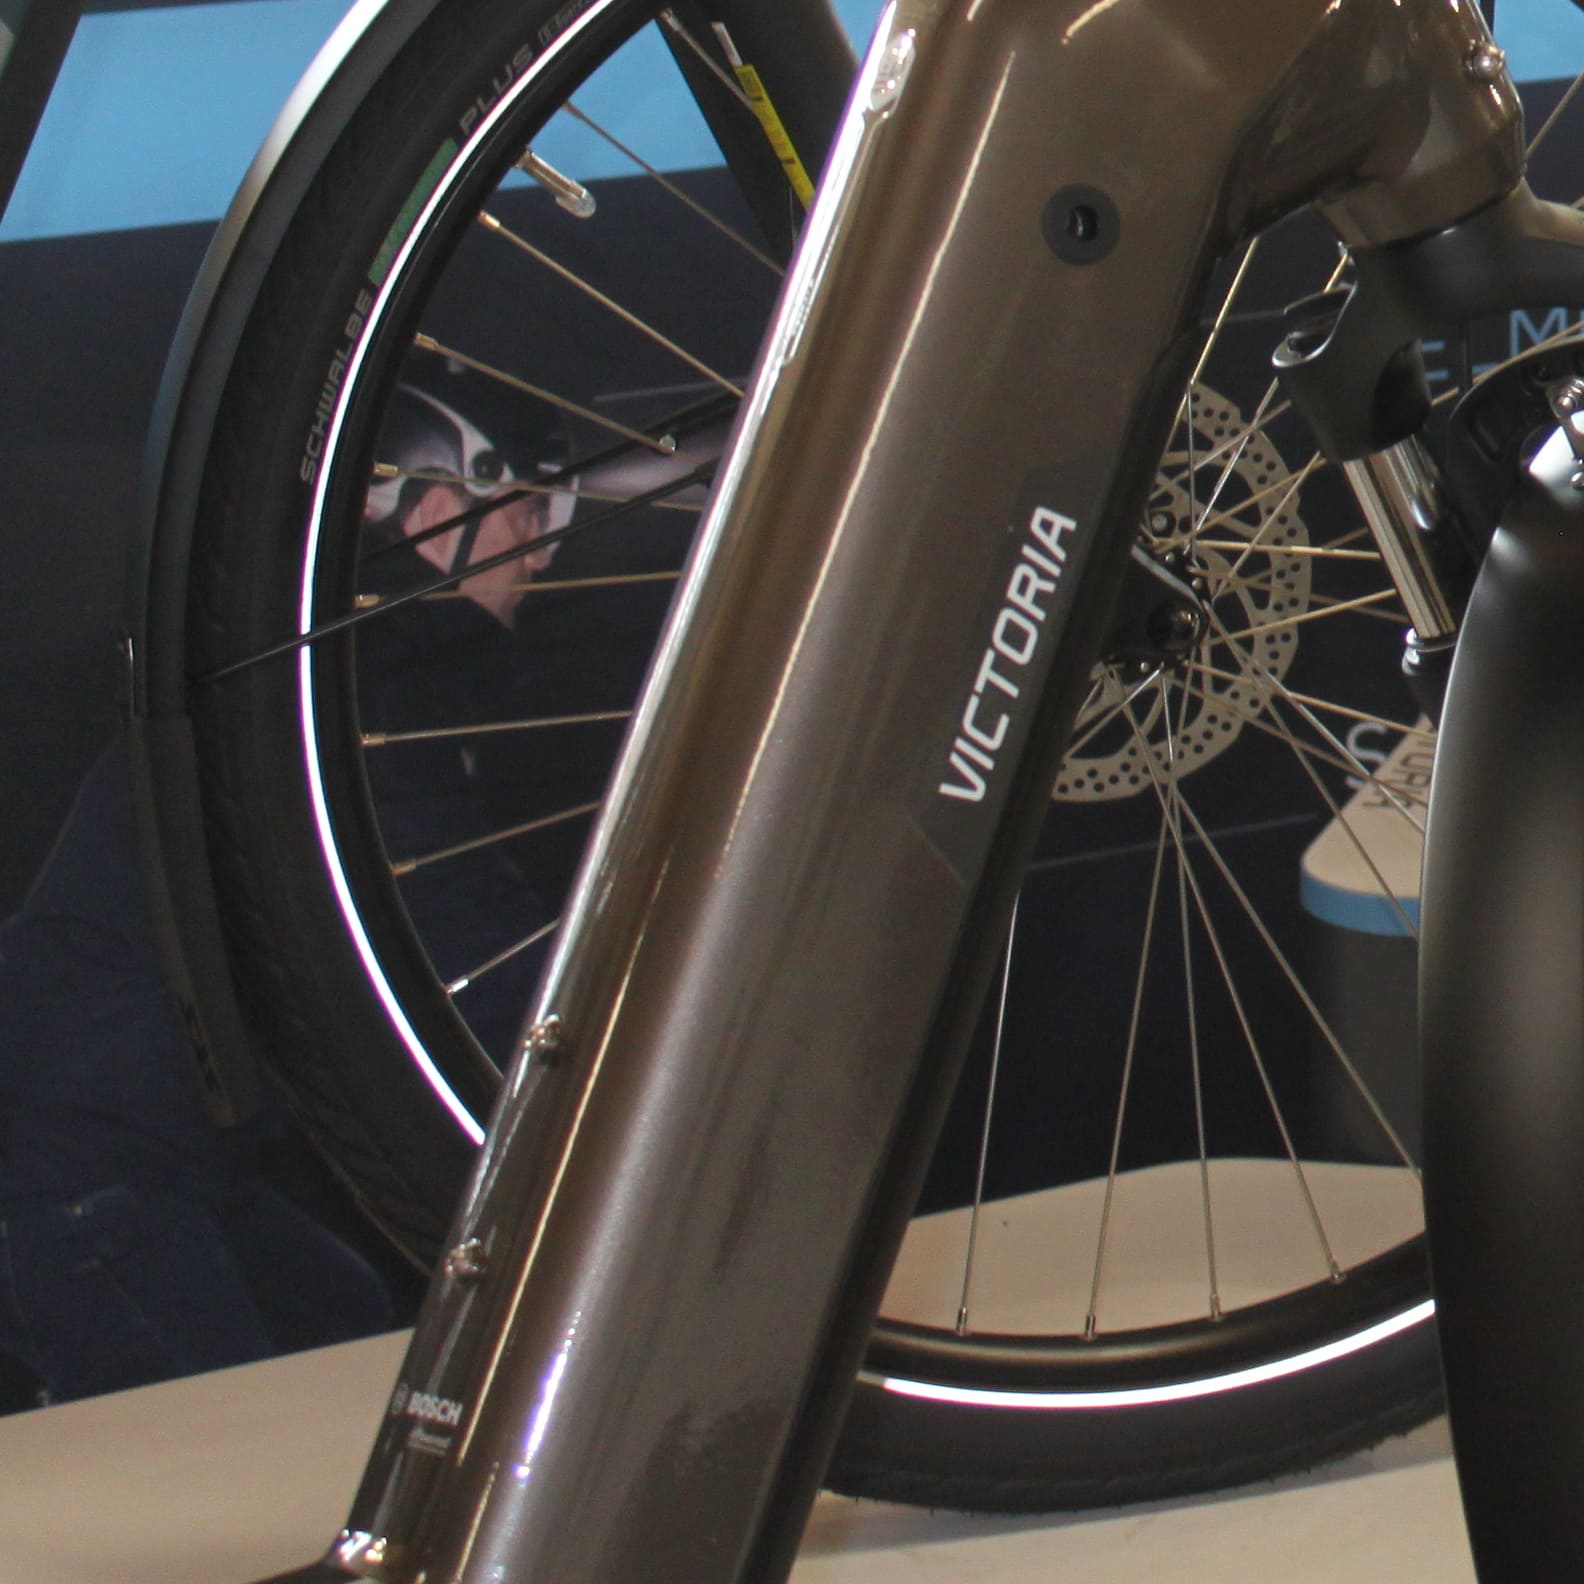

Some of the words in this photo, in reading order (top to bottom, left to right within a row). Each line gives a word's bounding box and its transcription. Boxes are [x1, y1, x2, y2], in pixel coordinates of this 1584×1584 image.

[458, 43, 534, 136] PLUS
[300, 287, 373, 486] SCHWALBE
[938, 505, 1077, 803] VICTORIA
[407, 1391, 463, 1426] BOSCH
